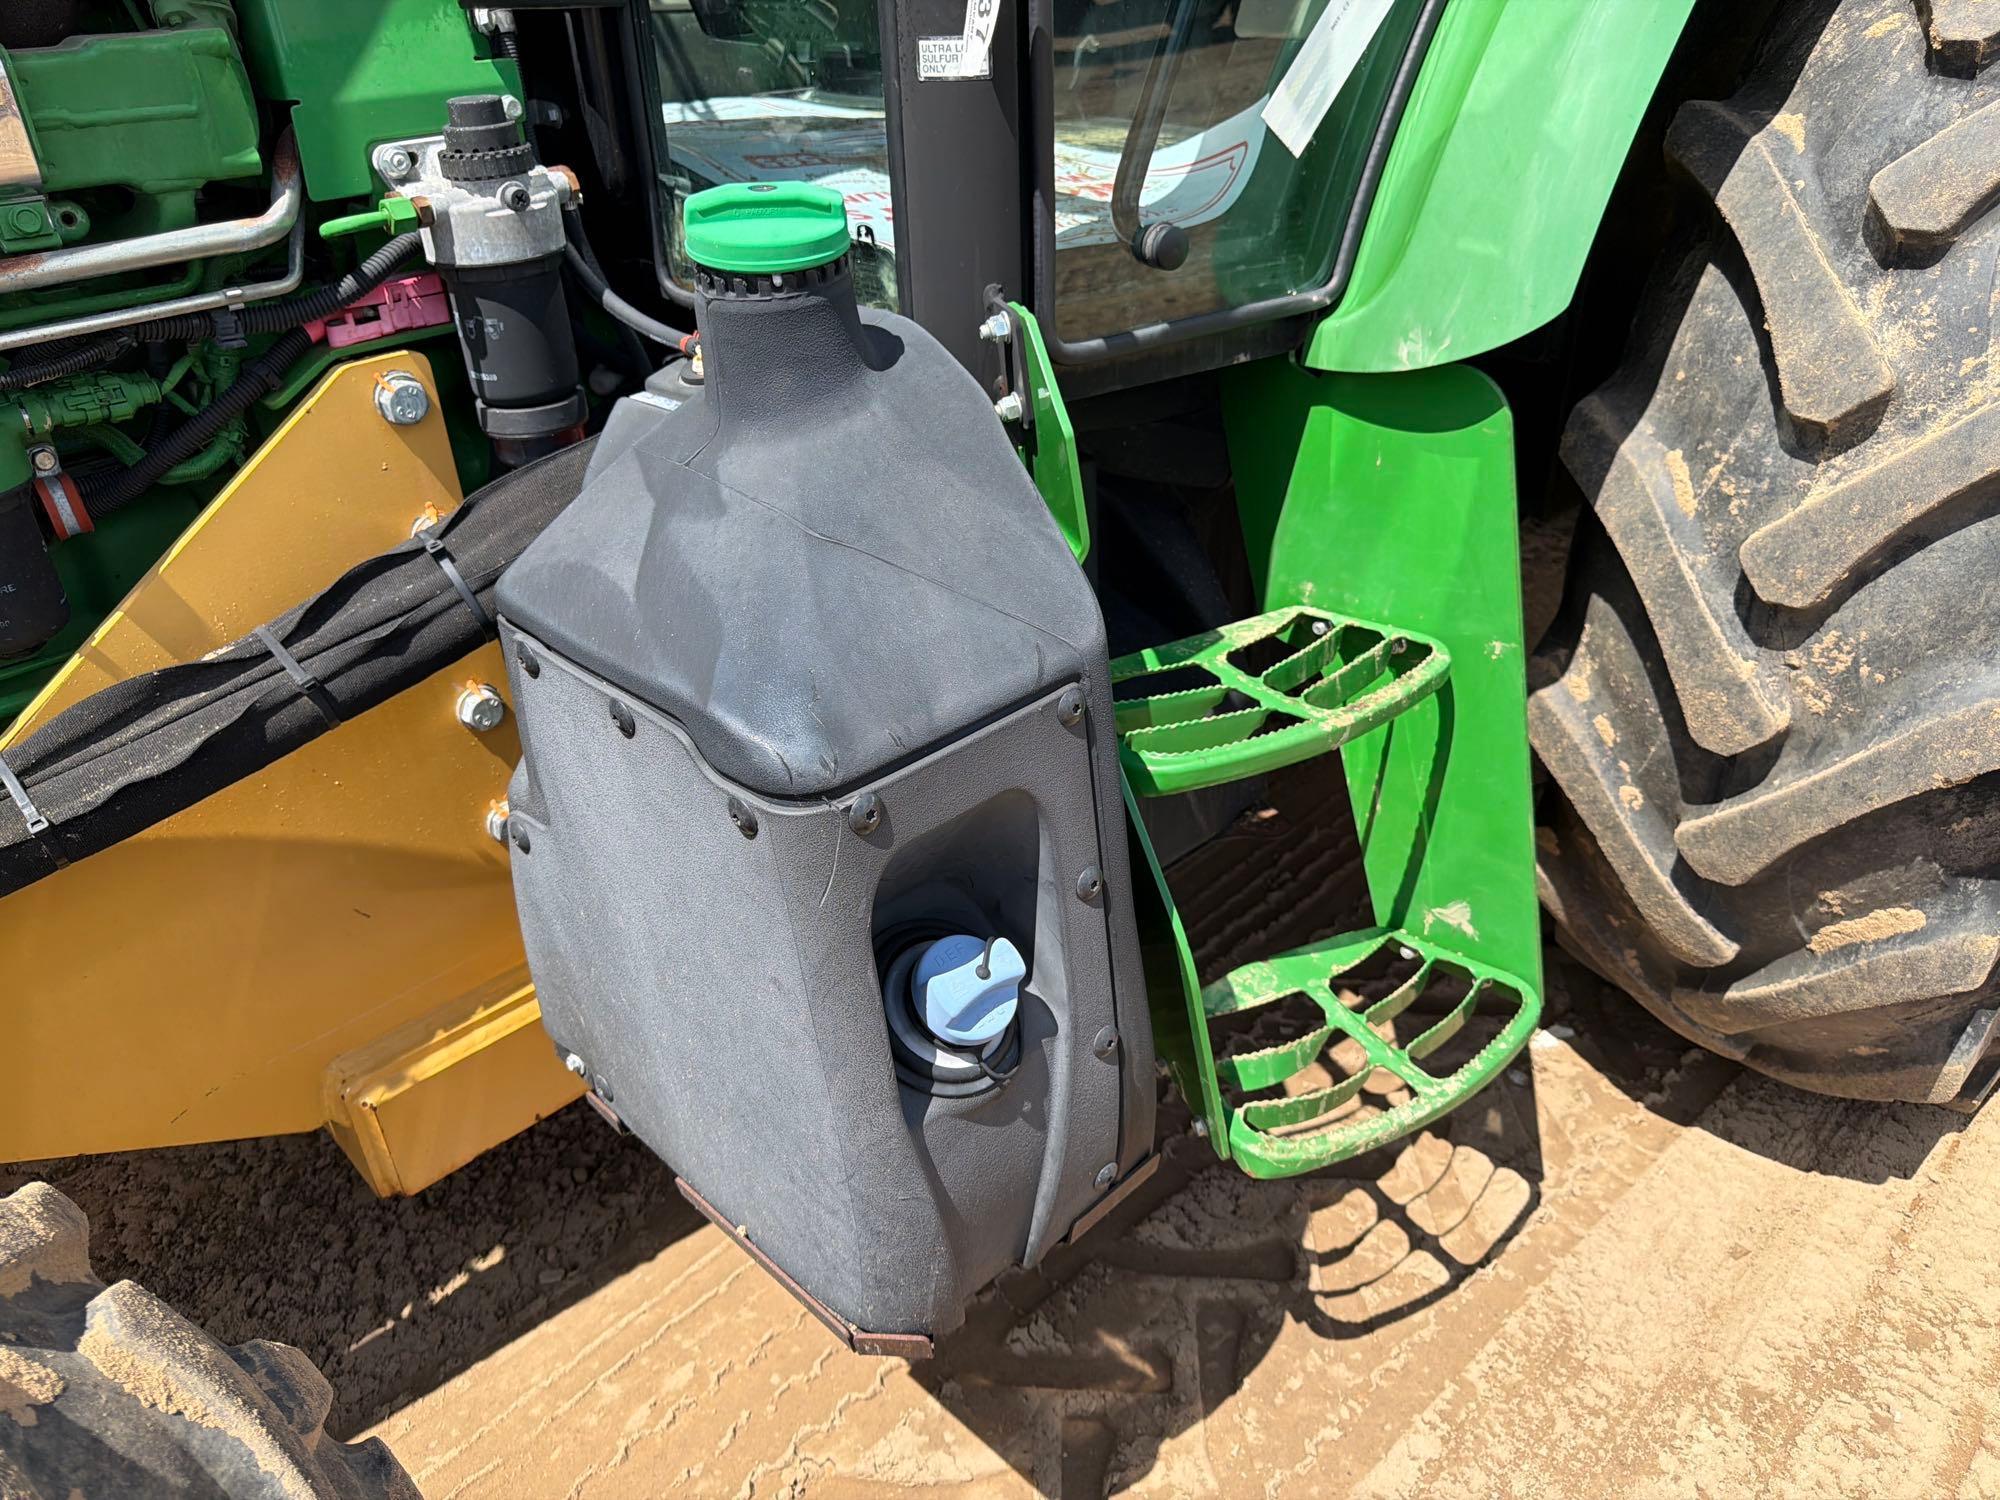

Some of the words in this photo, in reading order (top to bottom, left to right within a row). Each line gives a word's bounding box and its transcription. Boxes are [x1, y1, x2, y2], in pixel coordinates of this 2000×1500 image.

[921, 43, 952, 54] ULTRA
[922, 53, 959, 63] SULFUR
[922, 64, 946, 74] ONLY
